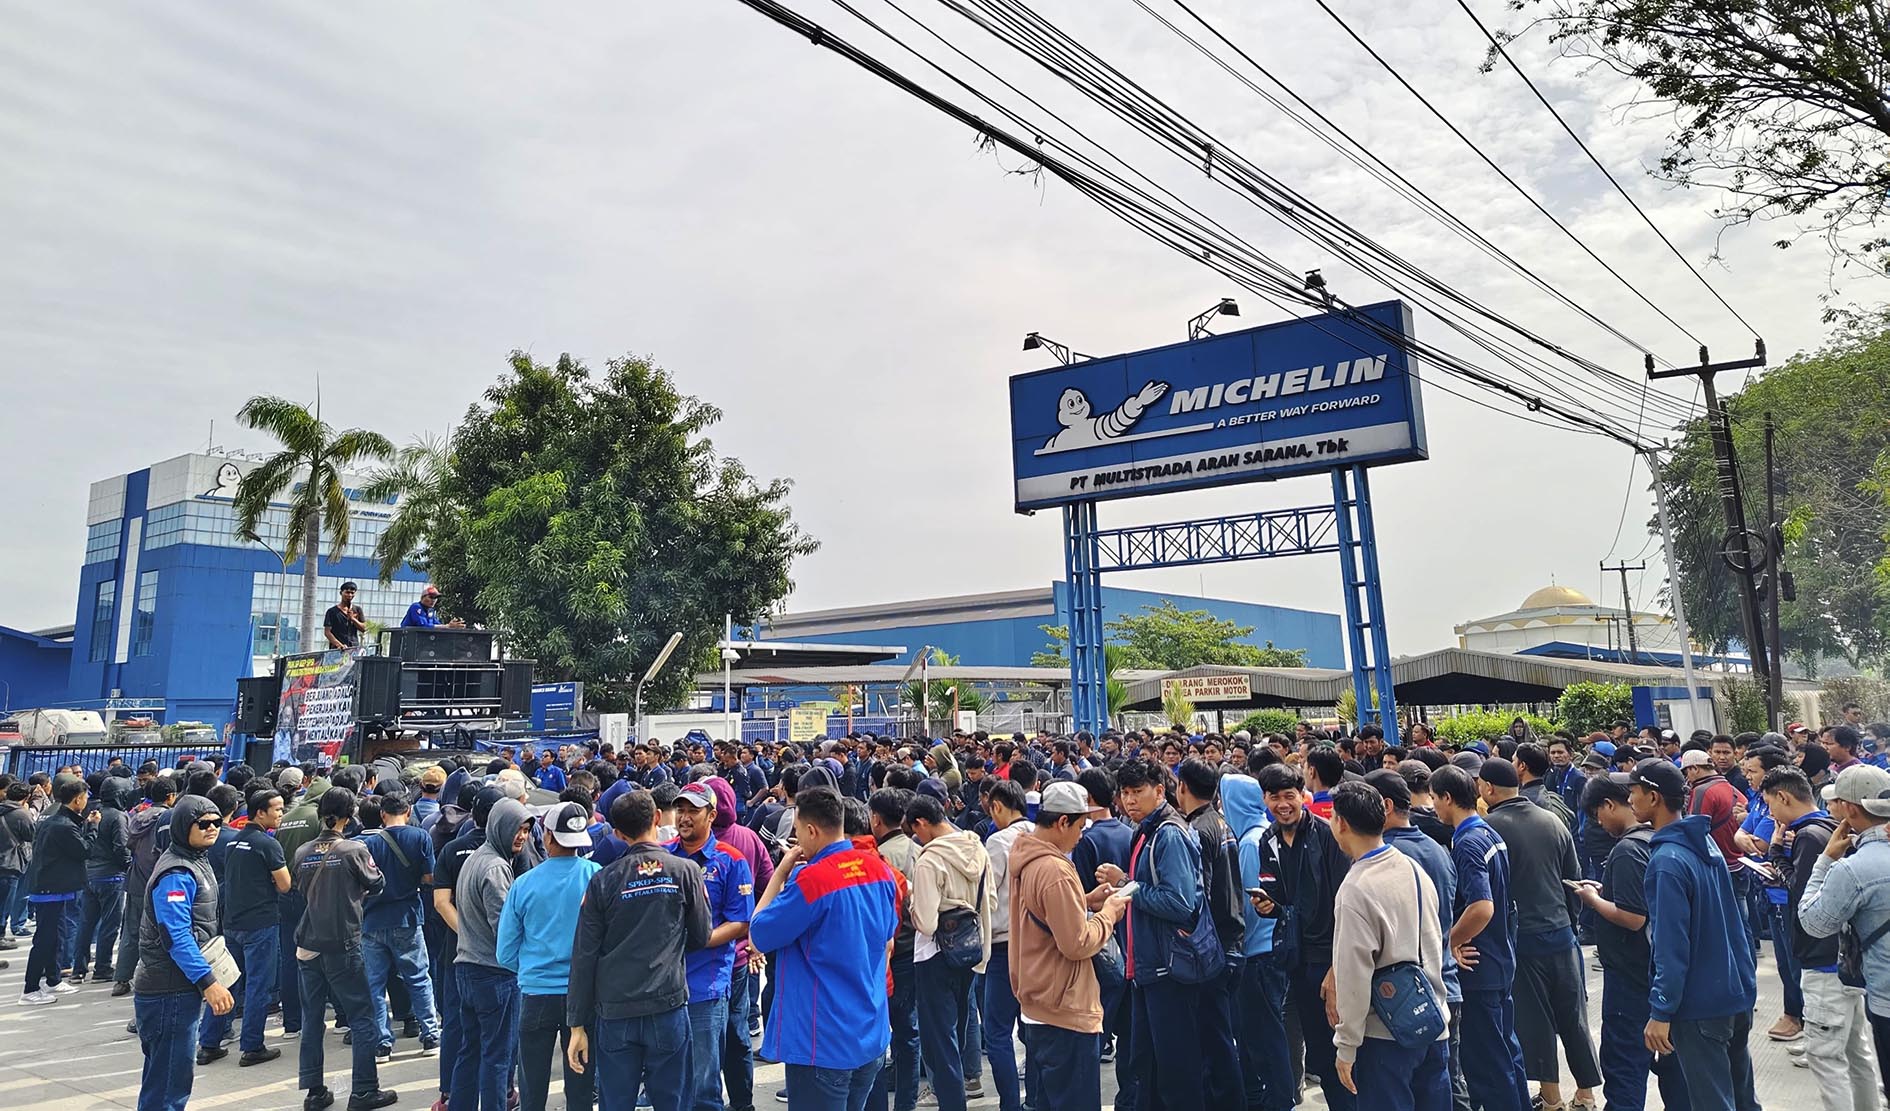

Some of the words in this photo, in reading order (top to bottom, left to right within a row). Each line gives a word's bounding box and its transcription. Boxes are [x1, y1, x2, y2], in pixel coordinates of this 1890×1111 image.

[1169, 354, 1387, 415] MICHELIN
[1216, 418, 1226, 428] A
[1229, 410, 1277, 426] BETTER
[1280, 405, 1308, 418] WAY
[1311, 394, 1380, 413] FORWARD
[1070, 475, 1088, 490] PT
[1093, 460, 1192, 486] MULTISTRADA
[1196, 453, 1239, 472] ARAH
[1243, 443, 1313, 466] SARANA,
[1316, 438, 1349, 454] Tbk
[334, 685, 354, 699] ADALA
[1166, 678, 1203, 688] DRANG
[1207, 677, 1244, 687] MEROKOK
[1195, 687, 1220, 697] PARKIR
[1223, 686, 1248, 695] MOTOR
